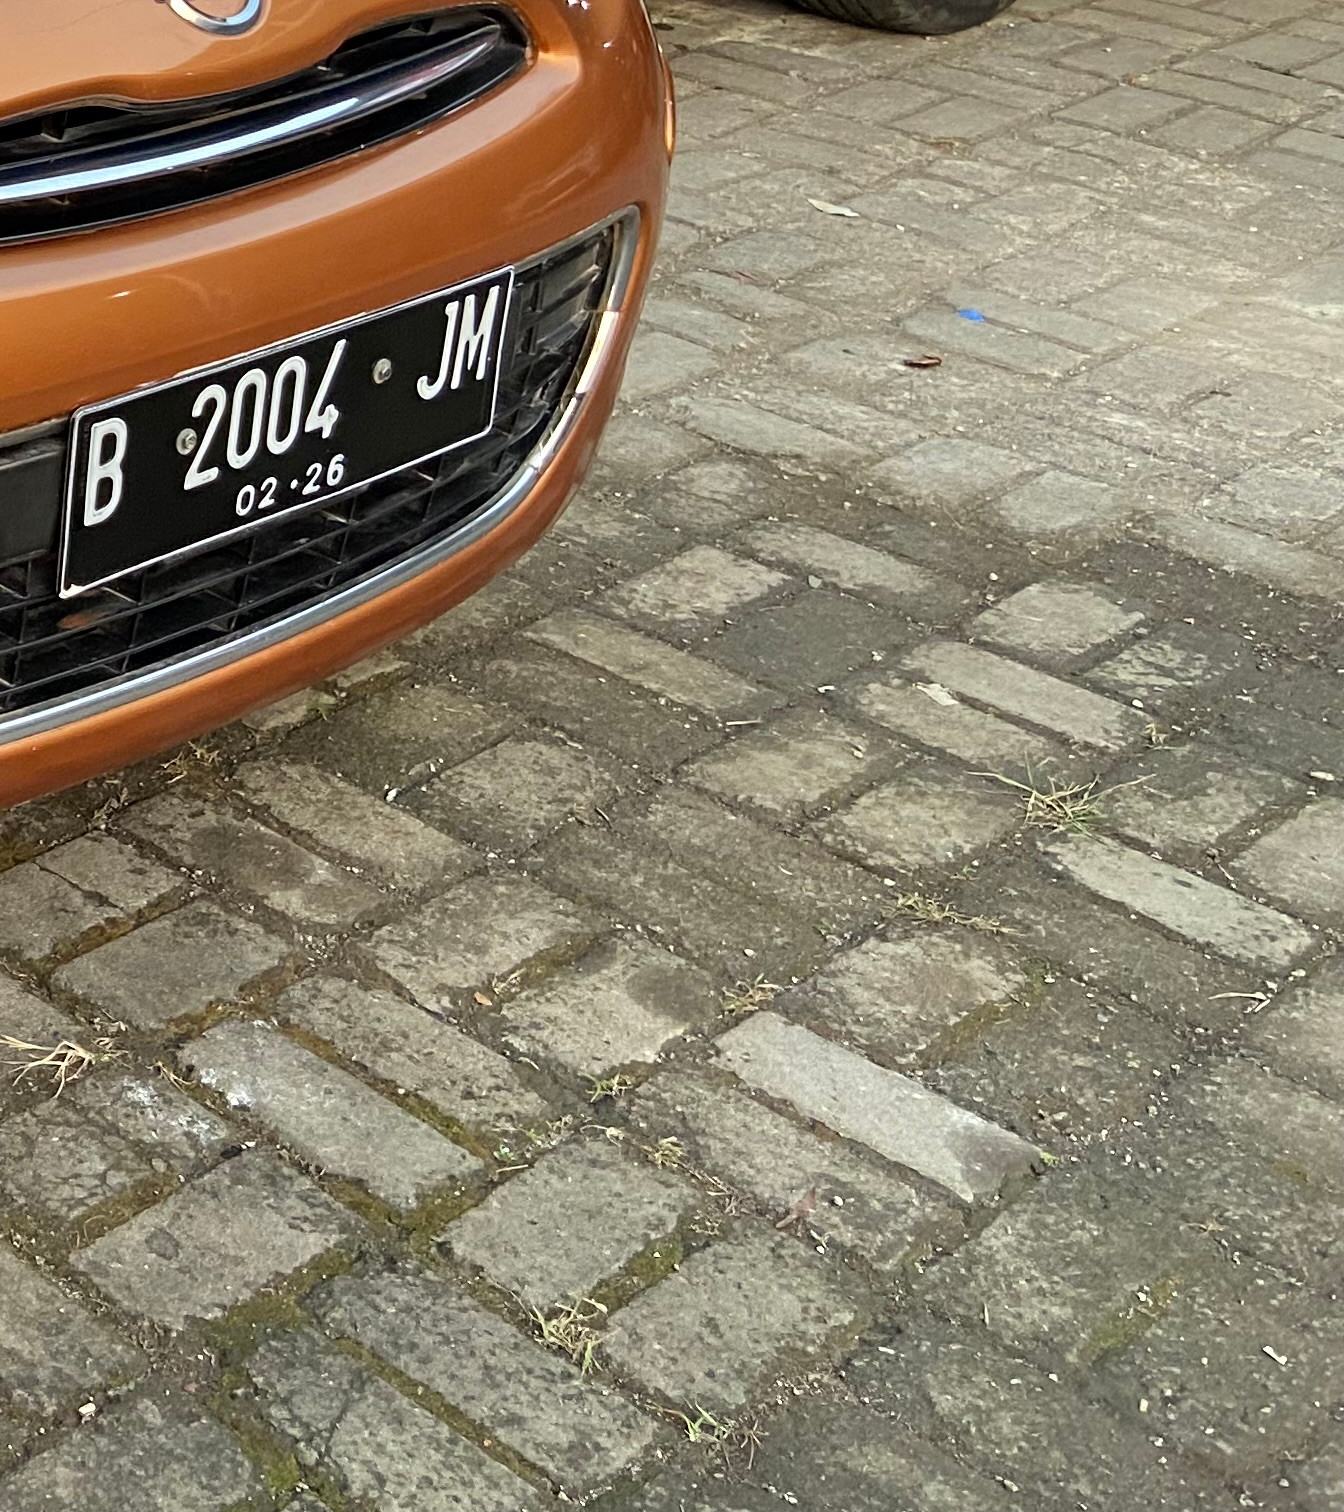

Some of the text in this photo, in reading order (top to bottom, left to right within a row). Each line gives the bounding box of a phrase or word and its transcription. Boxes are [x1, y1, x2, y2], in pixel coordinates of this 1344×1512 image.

[82, 284, 502, 526] B 2004 JM
